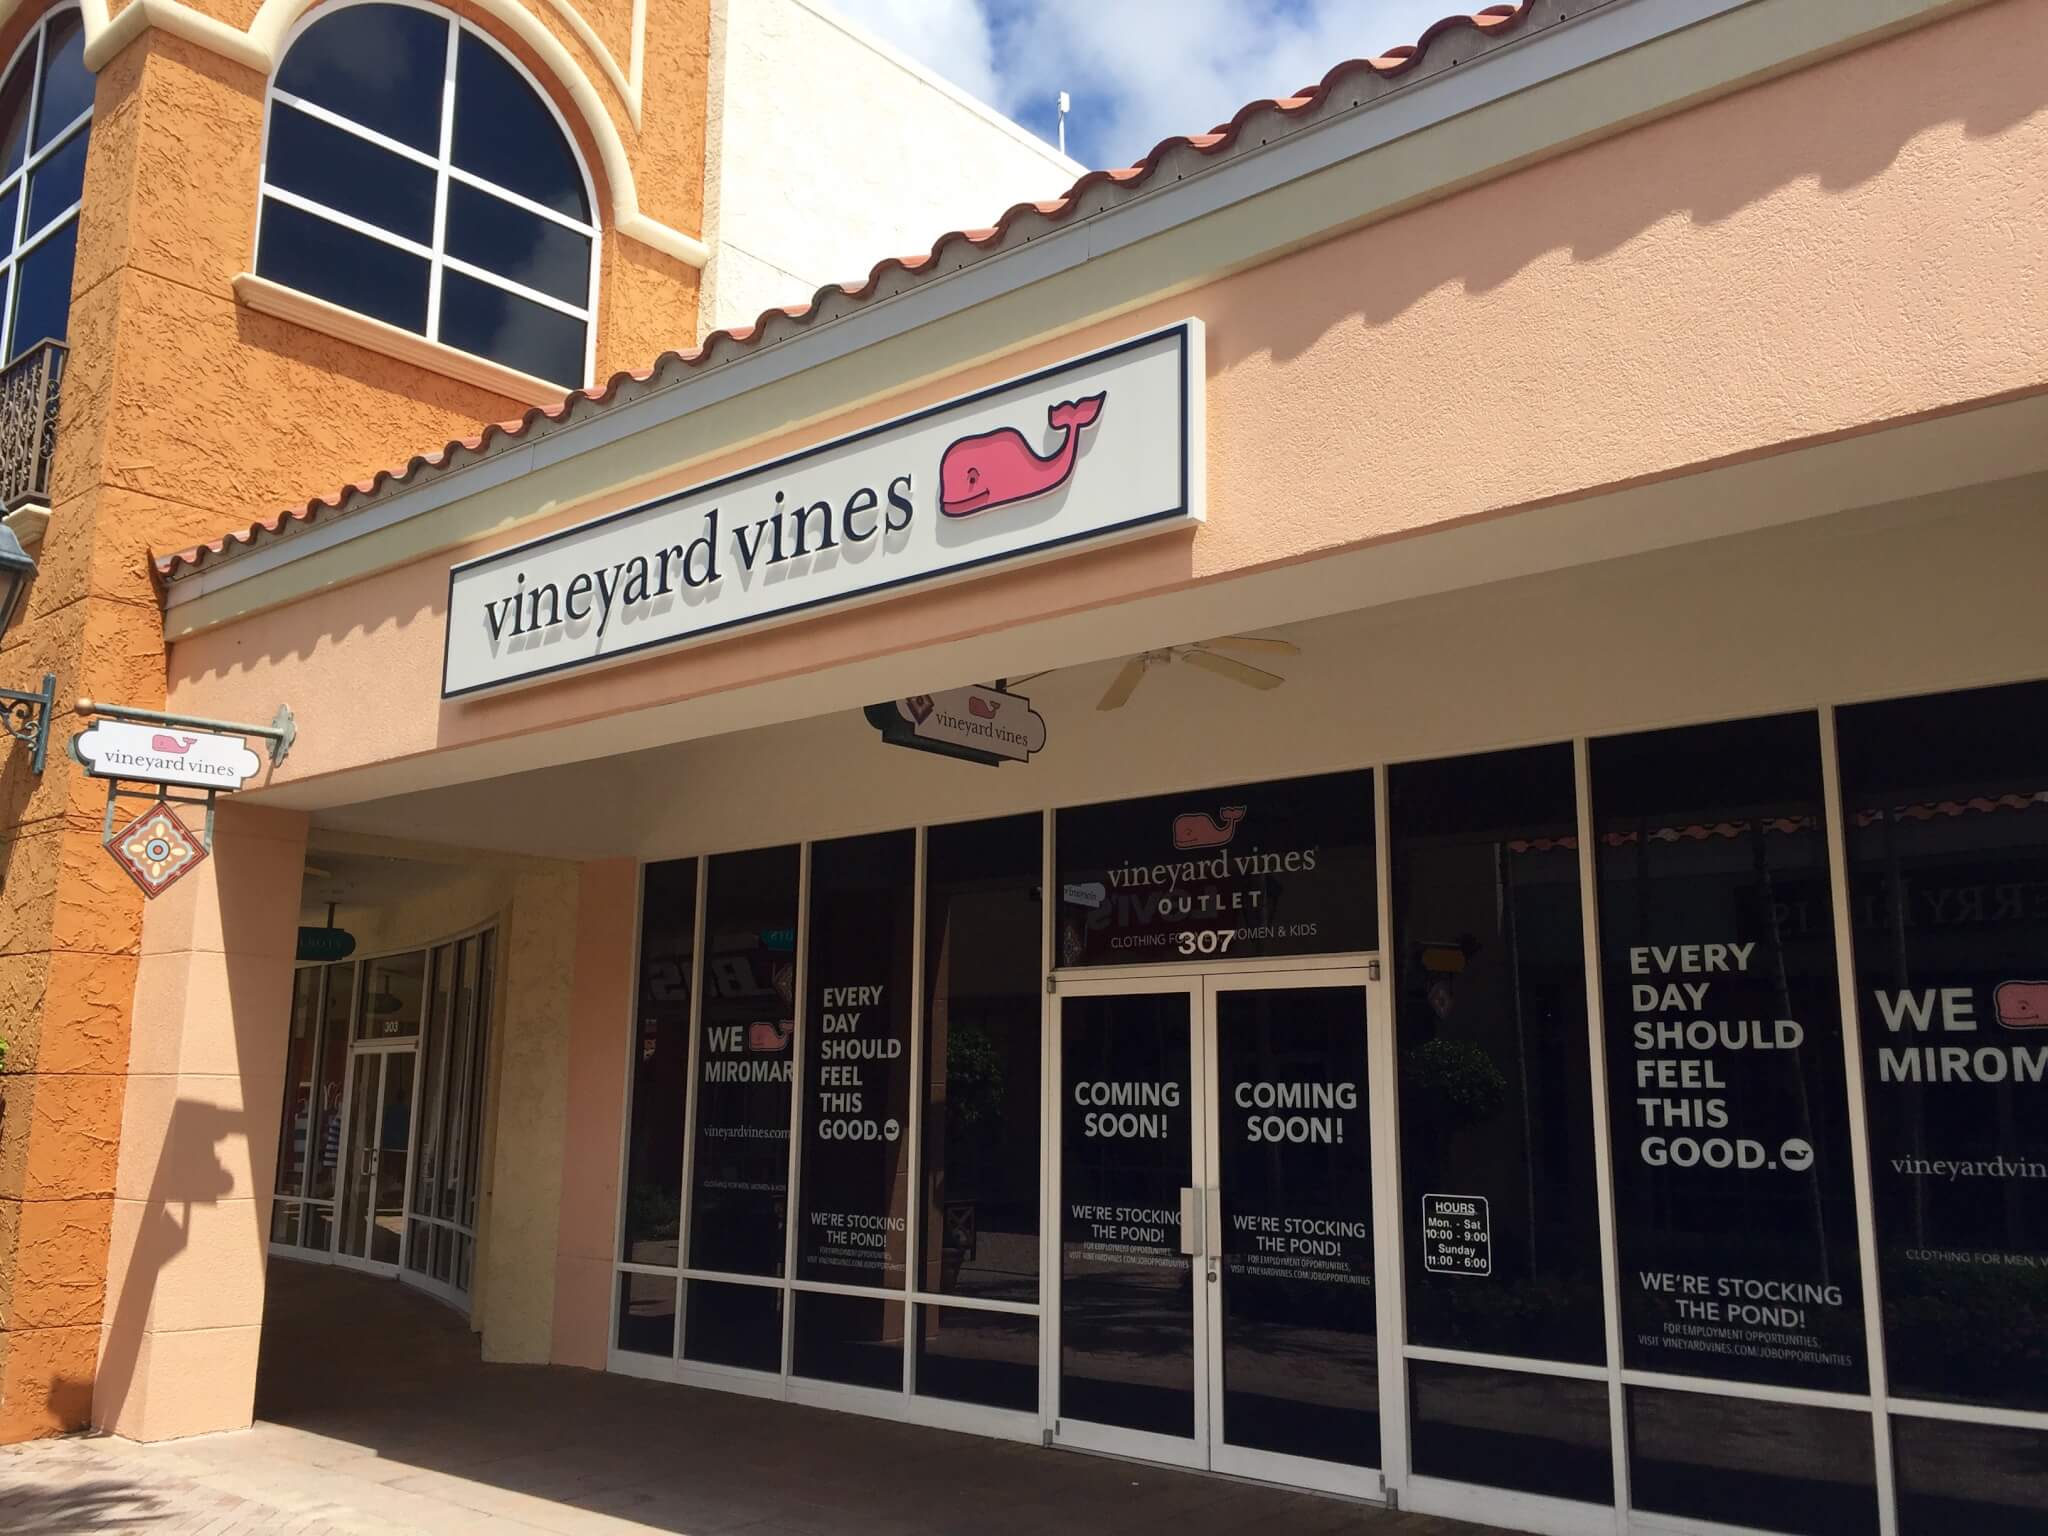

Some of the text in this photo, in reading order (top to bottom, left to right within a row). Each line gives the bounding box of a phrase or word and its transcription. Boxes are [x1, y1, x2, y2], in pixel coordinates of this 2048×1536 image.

[484, 473, 915, 640] vineyard vines
[936, 711, 1028, 747] vineyard vines
[105, 749, 235, 776] vineyard vines
[1107, 846, 1316, 893] vineyard vines
[1158, 890, 1262, 915] OUTLET
[1111, 934, 1166, 949] CLOTHING
[1290, 923, 1317, 936] KIDS
[1178, 929, 1236, 954] 307
[1630, 943, 1756, 975] EVERY
[823, 985, 883, 1007] EVERY
[1631, 982, 1711, 1013] DAY
[1873, 987, 1977, 1032] WE
[822, 1012, 861, 1033] DAY
[1633, 1019, 1804, 1050] SHOULD
[707, 1026, 743, 1053] WE
[820, 1038, 902, 1060] SHOULD
[704, 1060, 793, 1082] MIROMAR
[820, 1066, 863, 1086] FEEL
[1636, 1059, 1726, 1089] FEEL
[1878, 1046, 2048, 1083] MIROM
[819, 1092, 863, 1113] THIS
[1074, 1081, 1180, 1107] COMING
[1234, 1082, 1357, 1110] COMING
[1637, 1097, 1729, 1128] THIS
[818, 1119, 882, 1141] GOOD.
[1084, 1112, 1168, 1139] SOON!
[1247, 1115, 1343, 1144] SOON!
[1640, 1136, 1778, 1170] GOOD.
[1072, 1205, 1112, 1220] WE'RE
[1435, 1201, 1475, 1214] HOURS
[811, 1212, 905, 1232] WE'RE STOCKING
[1091, 1224, 1165, 1243] THE POND!
[1233, 1215, 1366, 1239] WE'RE STOCKING
[1428, 1217, 1453, 1228] Mon.
[1464, 1219, 1481, 1230] Sat
[826, 1230, 886, 1247] THE POND!
[1256, 1236, 1341, 1257] THE POND!
[1426, 1229, 1453, 1240] 10:00
[1464, 1231, 1487, 1242] 9:00
[1427, 1255, 1453, 1266] 11:00
[1464, 1257, 1487, 1269] 6:00
[1438, 1243, 1476, 1258] Sunday
[1905, 1249, 1971, 1264] CLOTHING
[1975, 1253, 2000, 1265] FOR
[1639, 1271, 1843, 1306] WE'RE STOCKING
[1675, 1299, 1806, 1329] THE POND!
[1638, 1334, 1659, 1346] VISIT
[1664, 1322, 1681, 1335] FOR
[1683, 1324, 1743, 1341] EMPLOYMENT
